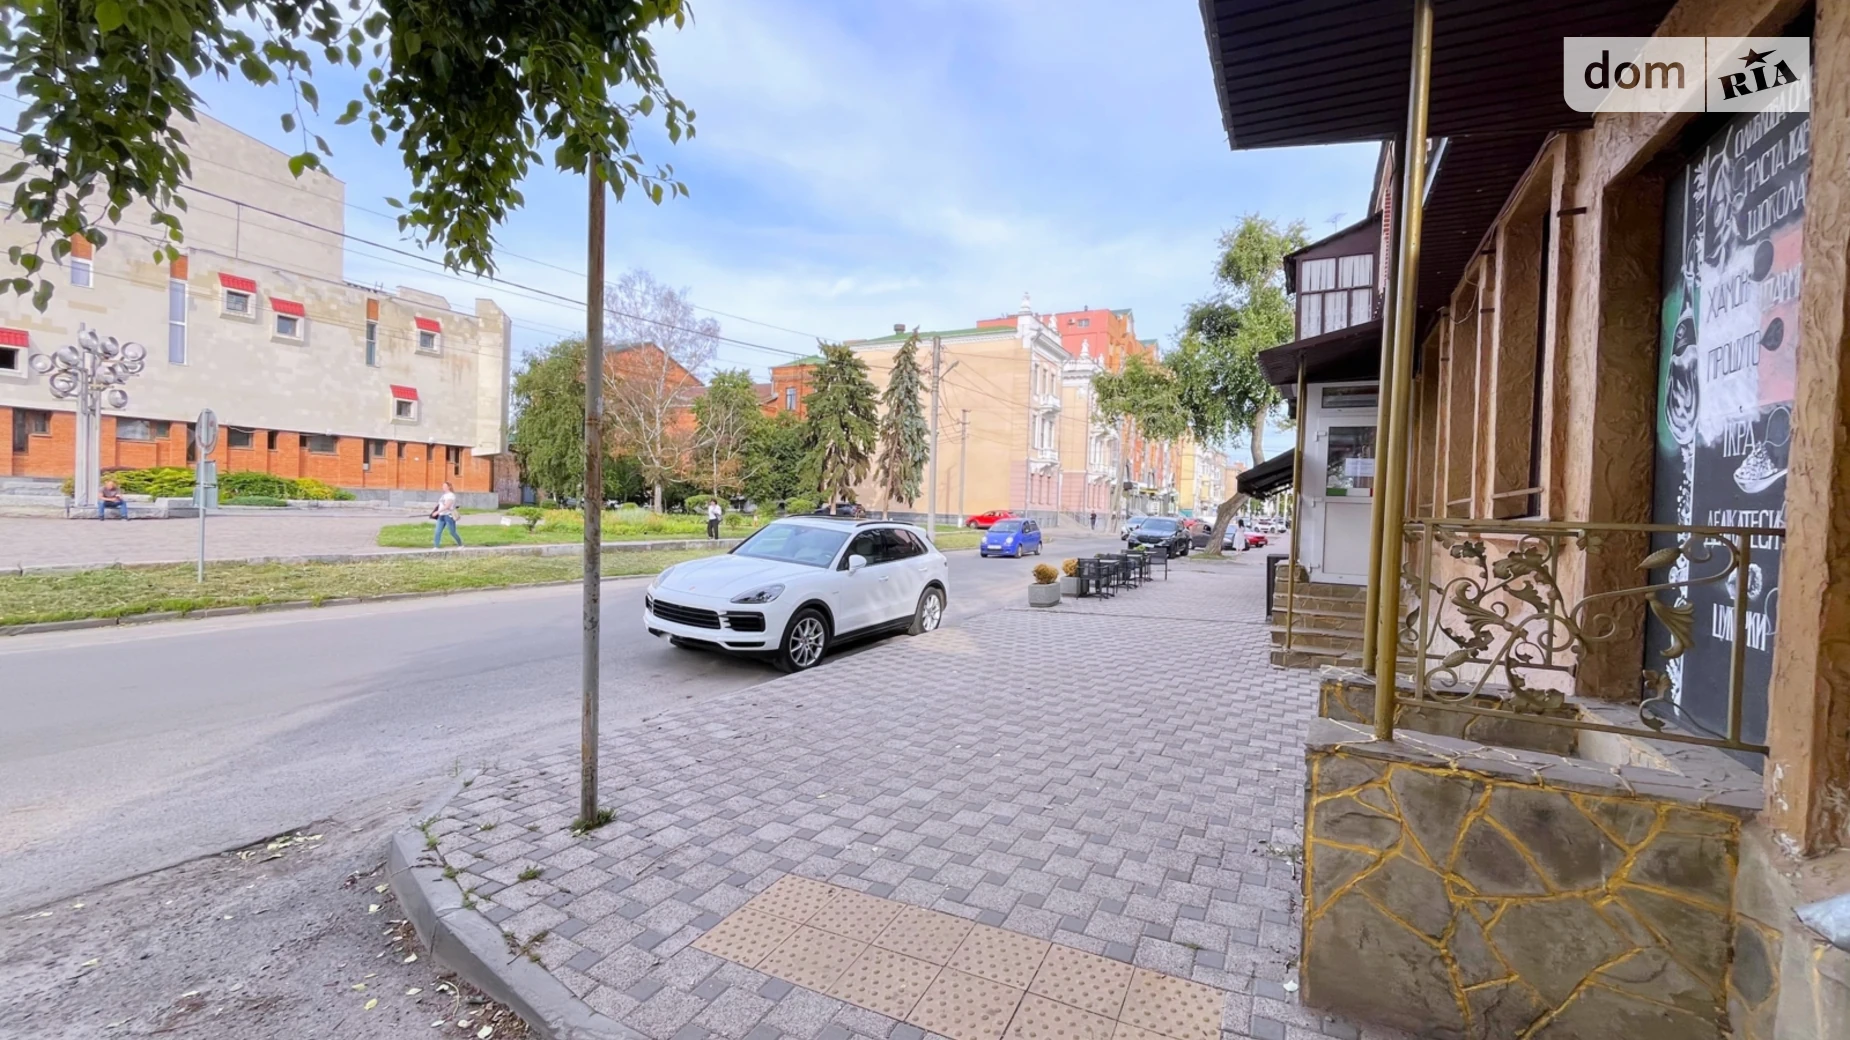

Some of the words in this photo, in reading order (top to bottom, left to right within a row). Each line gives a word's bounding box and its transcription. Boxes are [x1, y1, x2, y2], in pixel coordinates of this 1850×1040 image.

[1745, 139, 1785, 192] ПАСТА
[1707, 330, 1761, 382] ПРОШУТО
[1712, 603, 1767, 652] ЦУККИ
